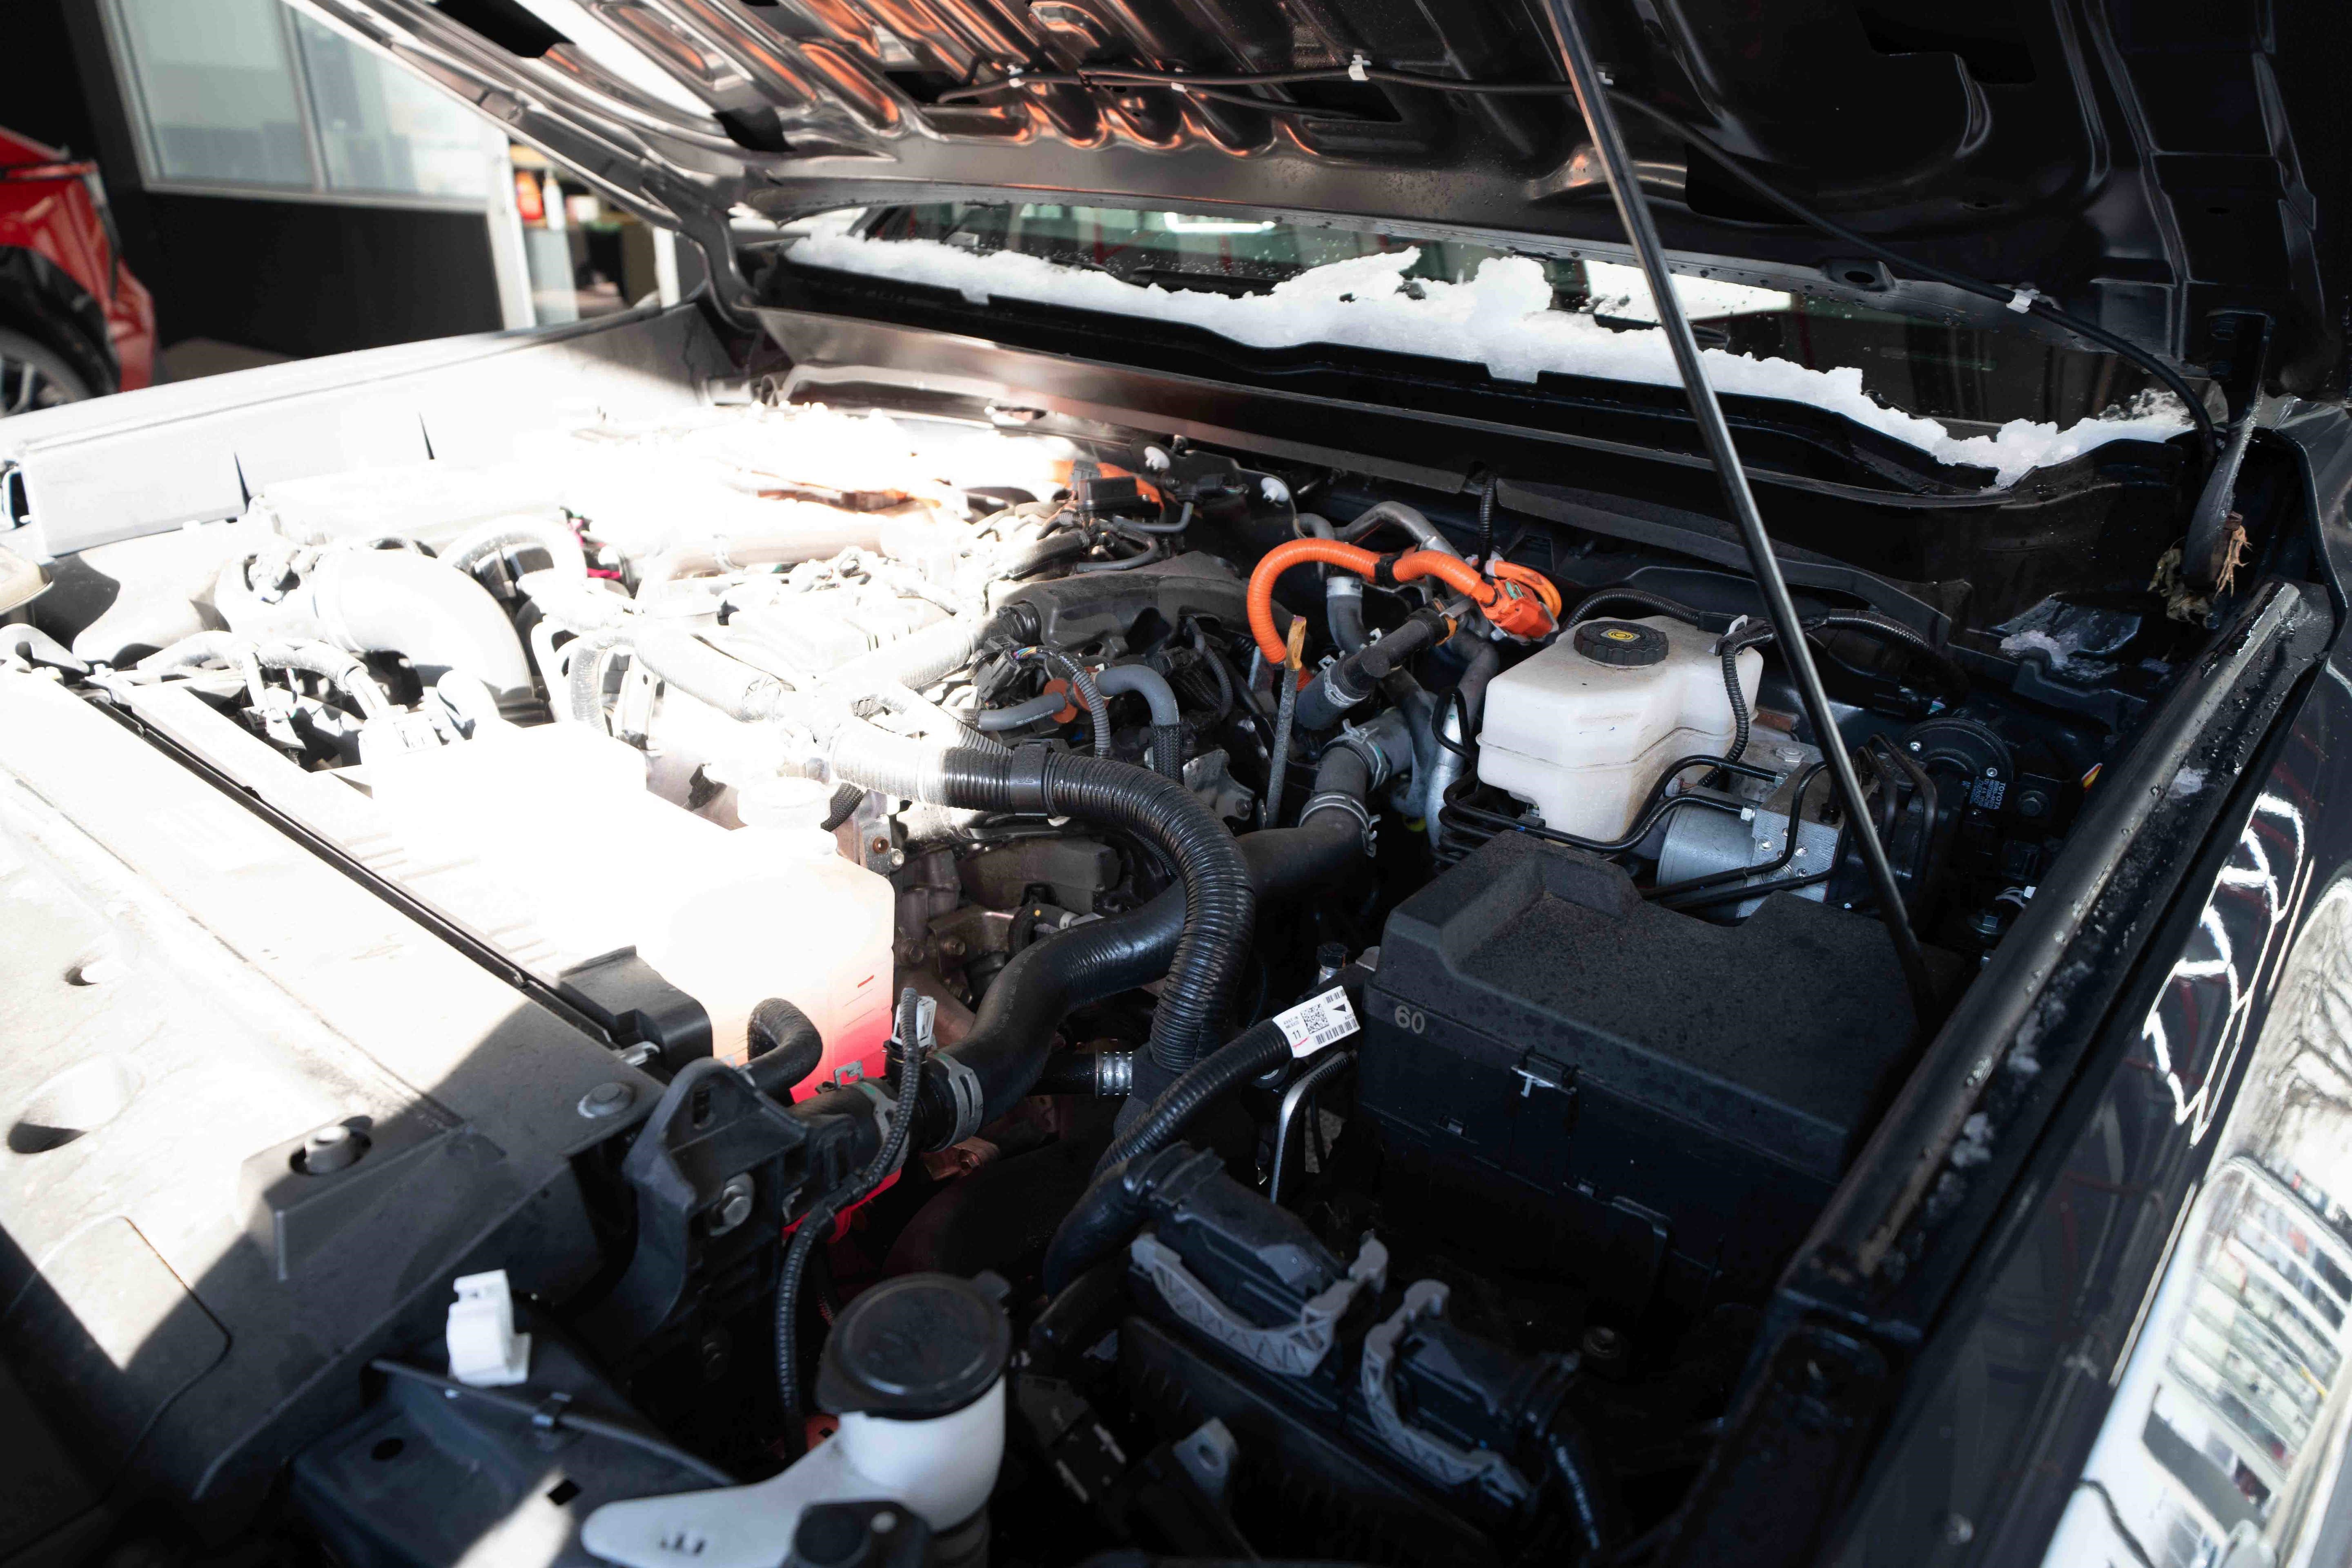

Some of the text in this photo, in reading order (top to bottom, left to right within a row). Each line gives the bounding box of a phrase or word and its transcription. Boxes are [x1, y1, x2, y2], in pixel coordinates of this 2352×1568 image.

[1973, 780, 1984, 803] DENSO
[1993, 782, 2006, 809] TOYOTA
[1395, 1004, 1425, 1034] 60
[1292, 1029, 1301, 1040] 11
